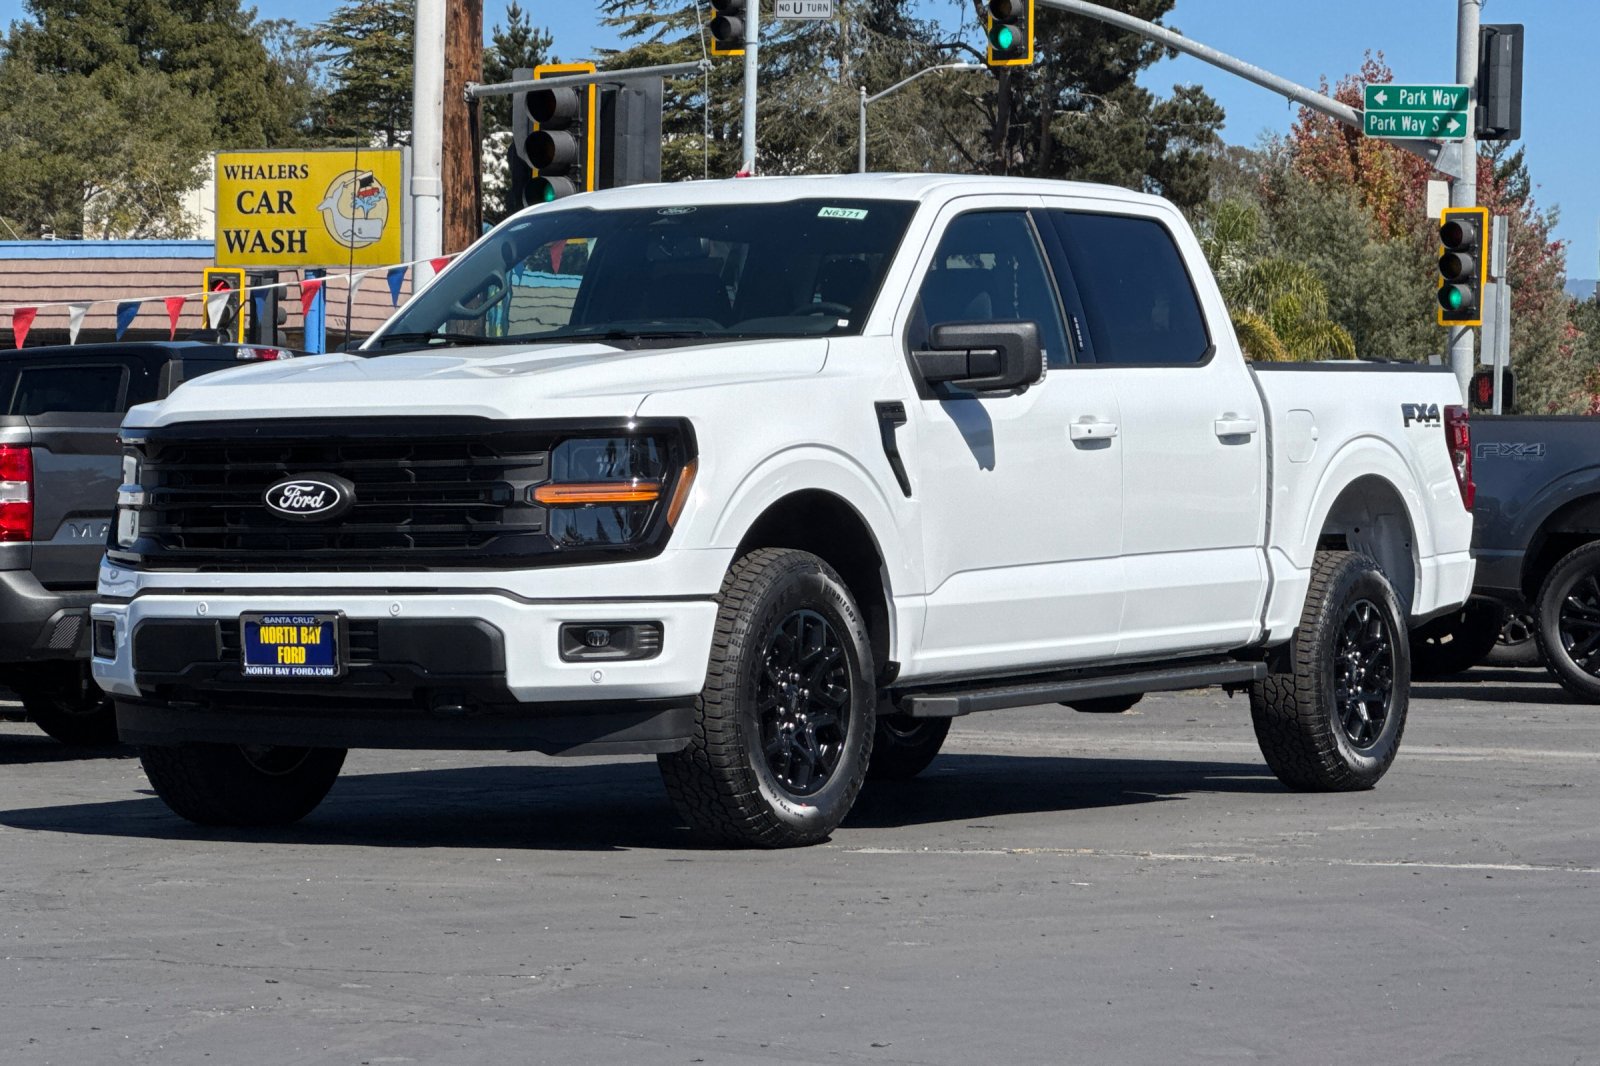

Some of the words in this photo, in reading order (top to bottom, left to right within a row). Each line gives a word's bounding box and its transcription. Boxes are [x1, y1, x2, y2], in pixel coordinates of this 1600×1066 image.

[779, 4, 791, 12] NO
[793, 2, 803, 15] U
[807, 4, 829, 12] TURN
[1399, 89, 1427, 105] Park
[1432, 89, 1459, 109] Way
[1370, 115, 1396, 131] Park
[1402, 116, 1426, 135] Way
[1432, 116, 1440, 132] S
[224, 164, 309, 180] WHALERS
[236, 190, 296, 215] CAR
[223, 229, 308, 254] WASH
[1401, 403, 1440, 427] FX4
[1475, 443, 1546, 459] FX4
[279, 484, 326, 508] Ford
[264, 616, 291, 624] SANTA
[260, 626, 298, 644] NORTH
[300, 626, 321, 644] BAY
[277, 646, 306, 664] FORD
[245, 667, 273, 675] NORTH
[275, 667, 290, 675] BAY
[292, 667, 333, 676] FORD.COM
